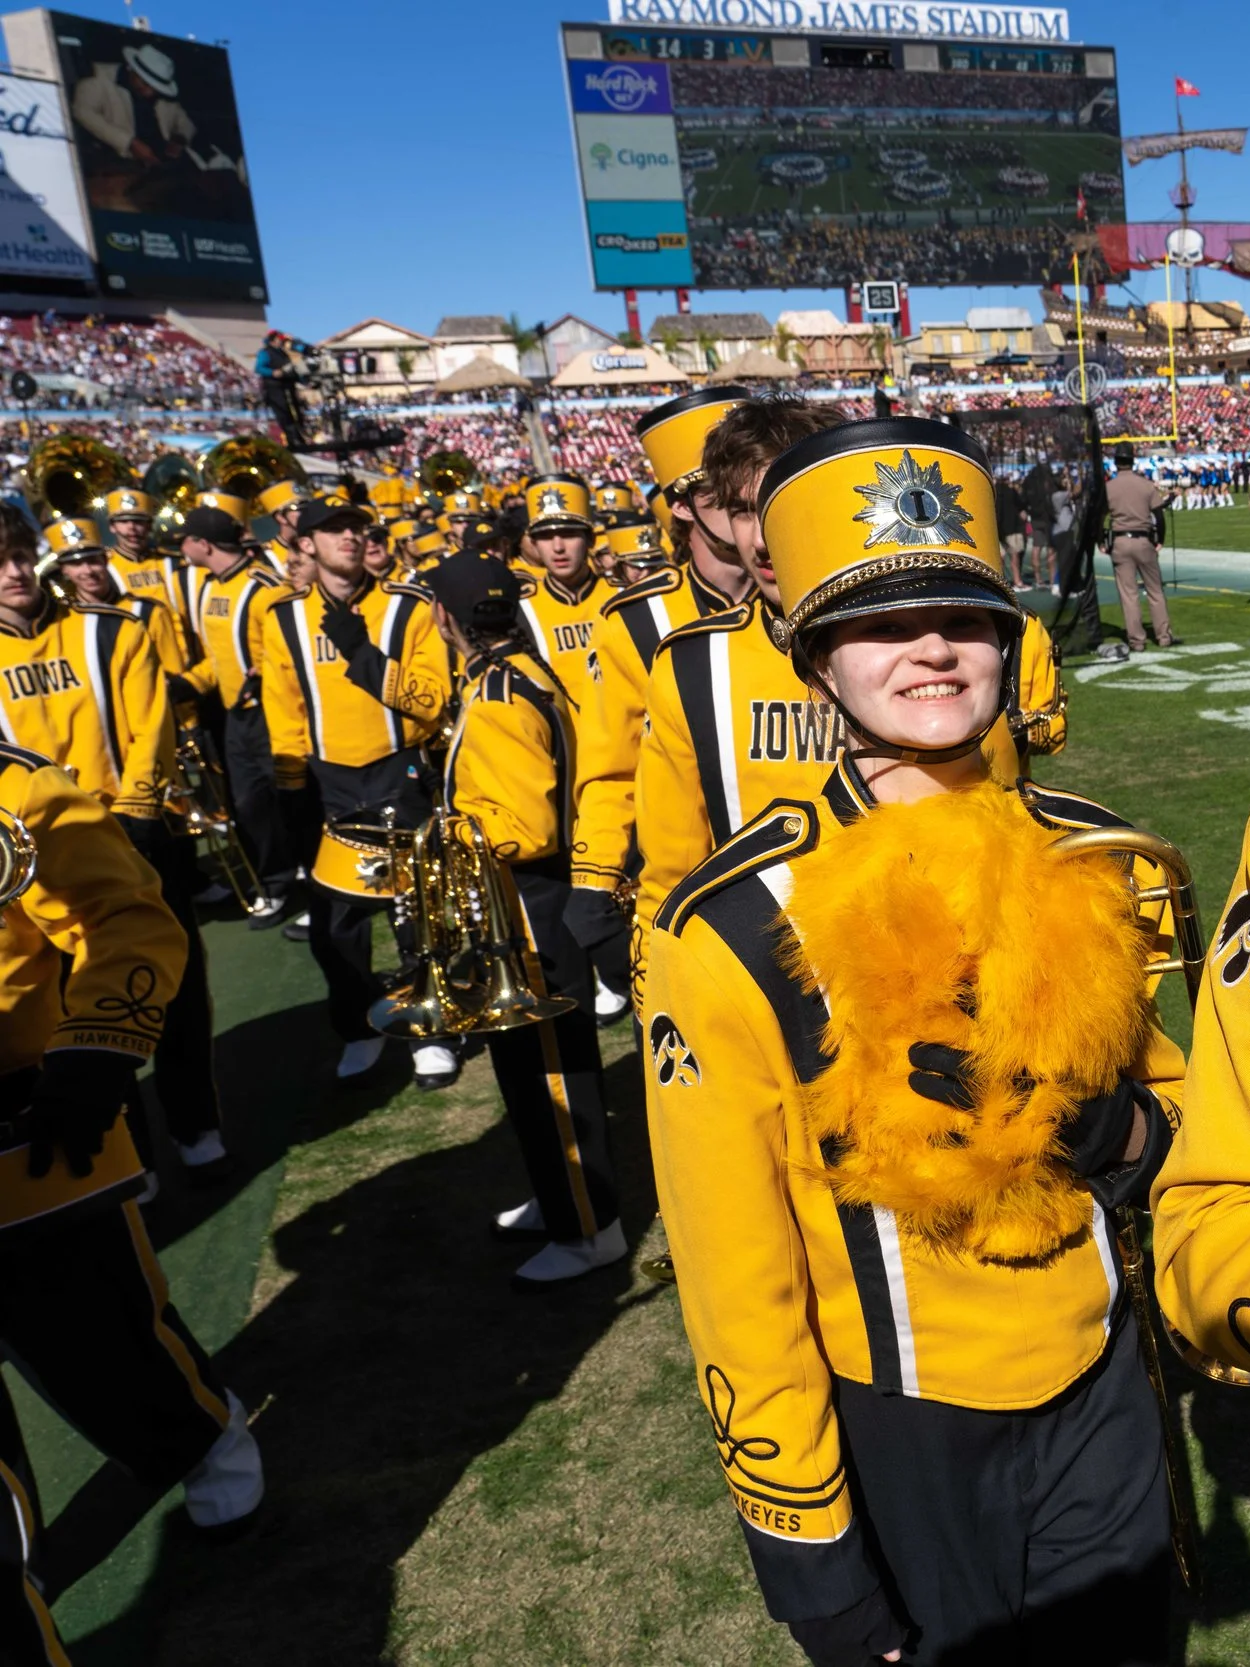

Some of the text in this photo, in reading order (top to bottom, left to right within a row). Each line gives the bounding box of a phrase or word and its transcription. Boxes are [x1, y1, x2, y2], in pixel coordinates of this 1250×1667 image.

[621, 0, 1063, 41] RAYMOND JAMES STADIUM
[657, 38, 681, 59] 14
[585, 74, 657, 95] Hard Rock
[617, 149, 668, 169] Cigna
[0, 242, 85, 266] tHealth
[871, 288, 892, 305] 25
[909, 490, 930, 521] I
[315, 635, 339, 663] IO
[553, 621, 594, 653] IOW
[2, 658, 82, 701] IOWA
[749, 700, 848, 763] IOWA
